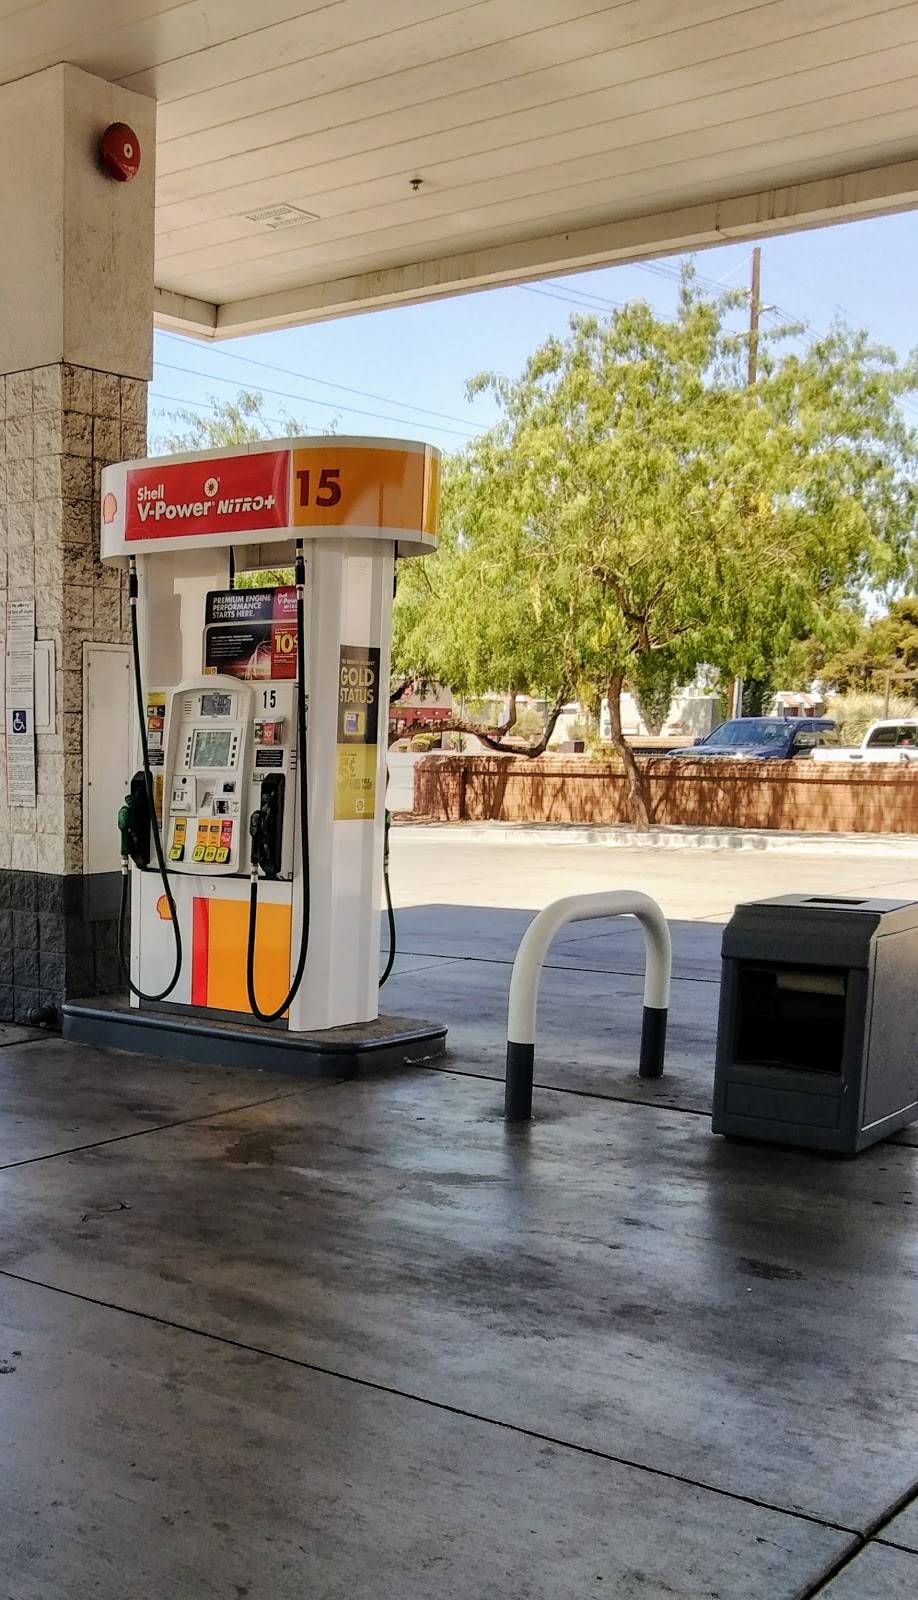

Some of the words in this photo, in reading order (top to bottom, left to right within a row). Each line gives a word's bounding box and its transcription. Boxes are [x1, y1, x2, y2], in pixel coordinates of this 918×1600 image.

[137, 484, 164, 501] Shell
[296, 469, 342, 507] 15
[137, 500, 212, 522] V-Power
[212, 595, 244, 604] PREMIUM
[245, 593, 272, 602] ENGINE
[212, 602, 262, 611] PERFORMANCE
[212, 610, 235, 618] STARTS
[236, 609, 256, 617] HERE.
[340, 666, 375, 687] GOLD
[263, 690, 276, 708] 15
[340, 687, 375, 704] STATUS
